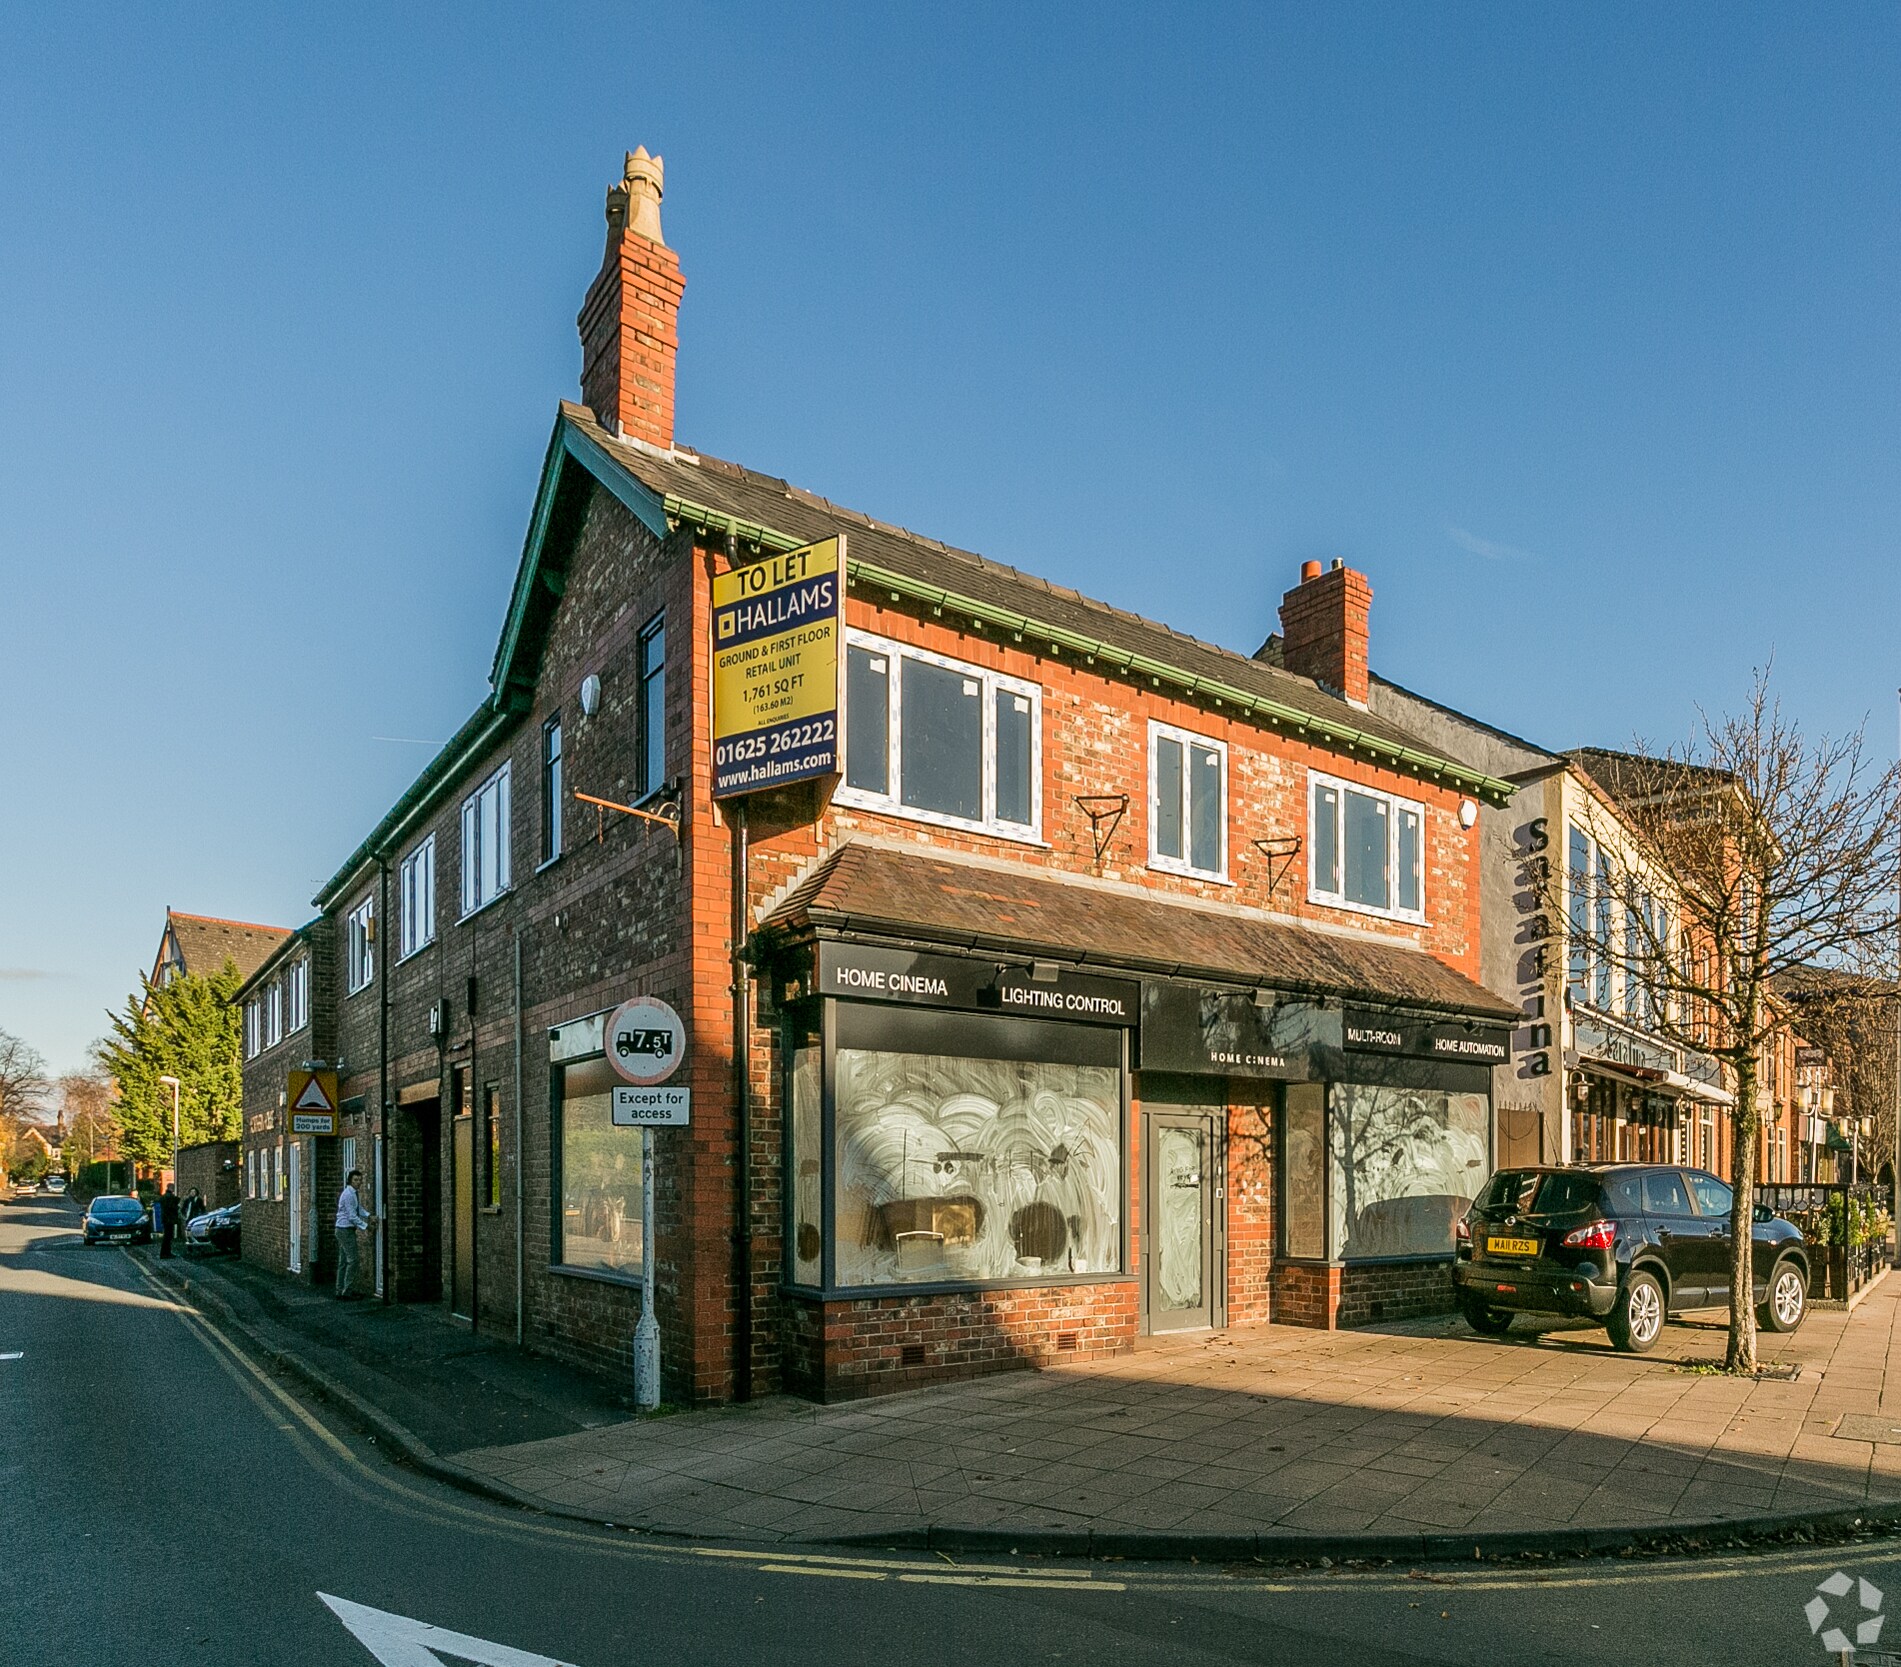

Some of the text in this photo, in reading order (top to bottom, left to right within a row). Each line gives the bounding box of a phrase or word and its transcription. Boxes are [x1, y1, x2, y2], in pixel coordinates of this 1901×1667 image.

[737, 550, 811, 596] TO LET
[738, 581, 832, 633] HALLAMS
[719, 626, 830, 668] GROUND & FIRST FLOOR
[745, 652, 801, 679] RETAIL UNIT
[742, 674, 804, 703] 1,761 SQ FT
[753, 695, 793, 715] (163.60 M2)
[716, 719, 834, 766] 01625 262222
[718, 751, 831, 788] www.hallams.com
[837, 967, 948, 996] HOME CINEMA
[1002, 986, 1125, 1016] LIGHTING CONTROL
[635, 1031, 670, 1048] 7.5T
[1347, 1027, 1401, 1046] MULTI-ROOM
[1435, 1038, 1505, 1057] HOME AUTOMATION
[1210, 1051, 1285, 1067] HOME CINEMA
[620, 1092, 683, 1106] Except for
[631, 1109, 672, 1119] access
[1512, 1240, 1530, 1252] RZS
